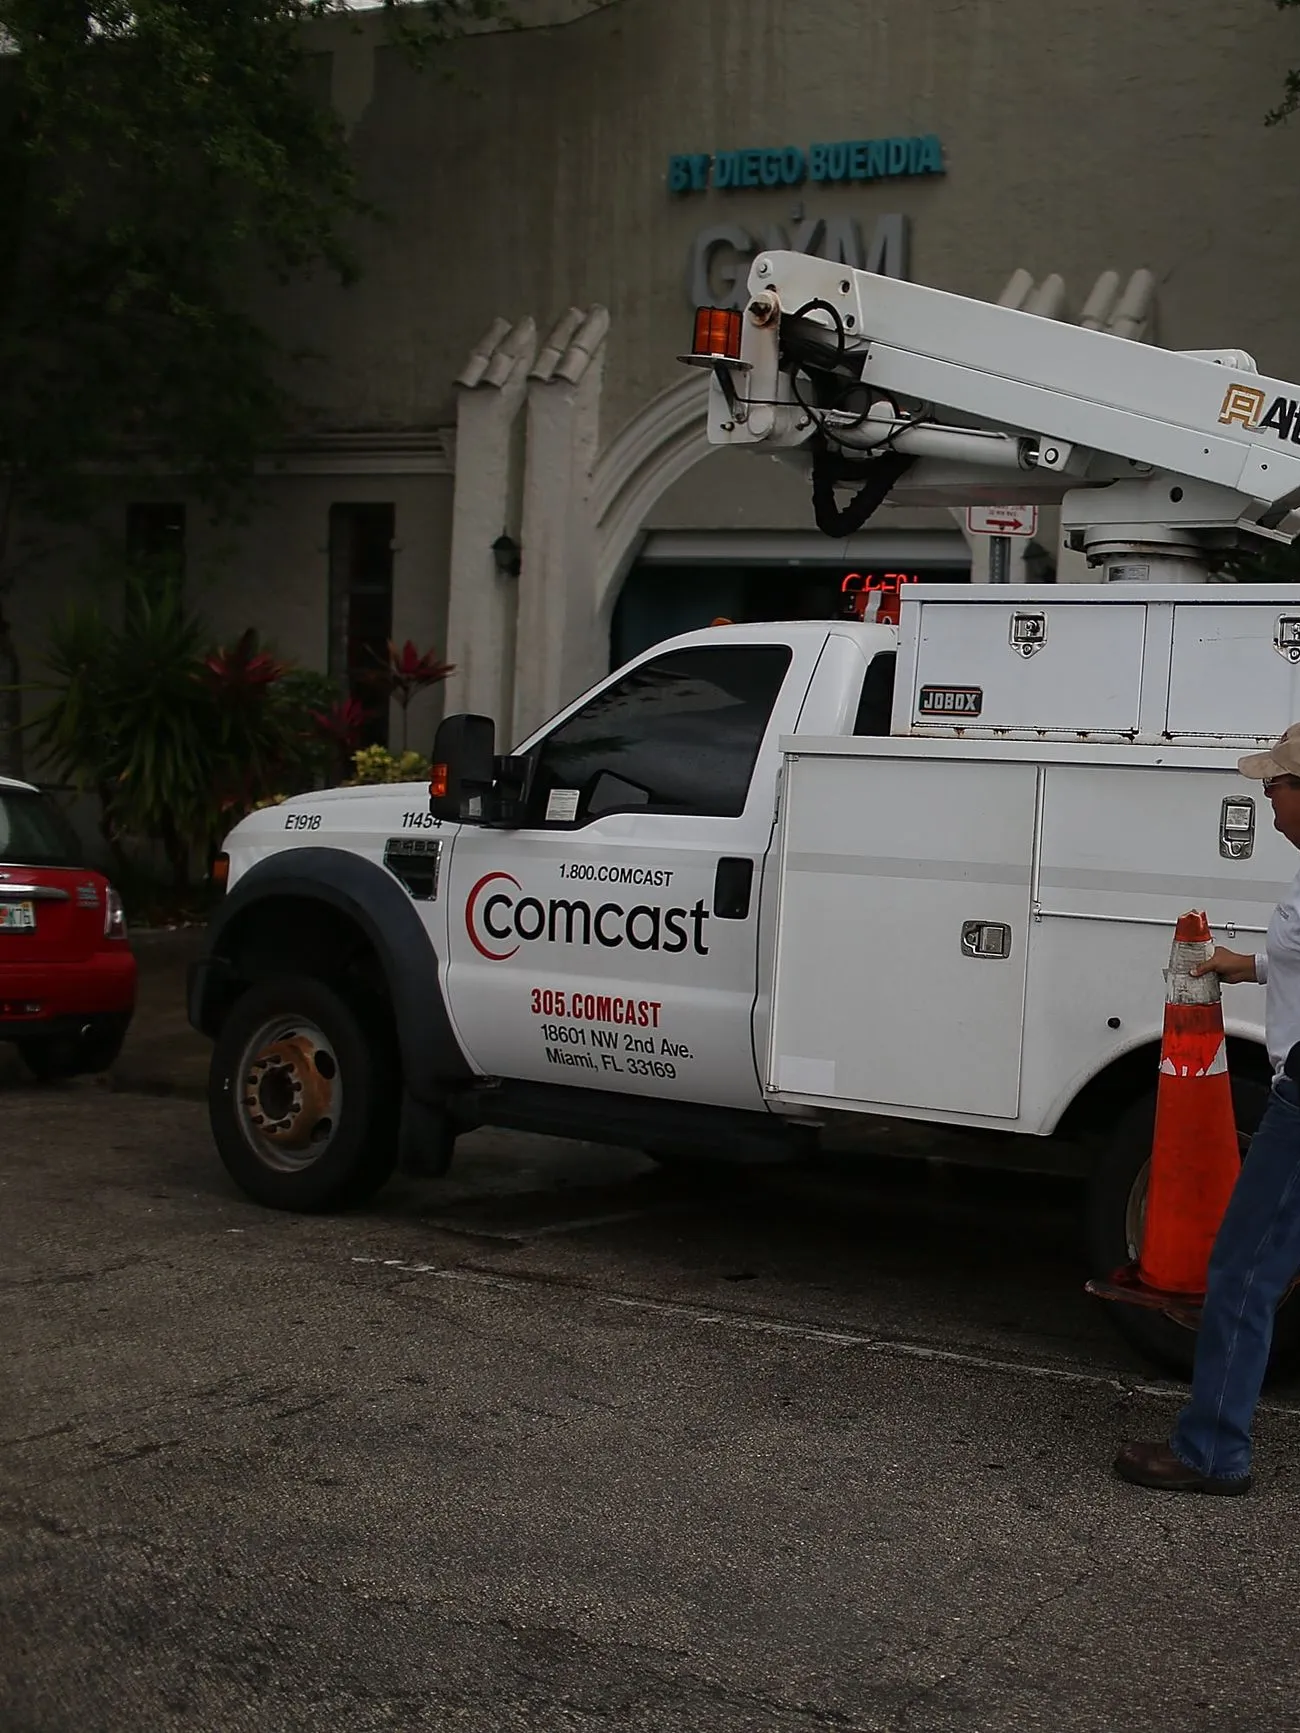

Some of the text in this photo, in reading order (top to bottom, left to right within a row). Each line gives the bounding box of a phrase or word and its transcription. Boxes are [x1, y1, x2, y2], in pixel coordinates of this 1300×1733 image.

[667, 134, 946, 192] BY DIEGO BUENDIA
[923, 692, 977, 711] JOBOX
[285, 814, 322, 830] E1918
[402, 812, 443, 829] 11454
[559, 863, 674, 887] 1.800.COMCAST
[531, 988, 662, 1028] 305.COMCAST
[541, 1024, 694, 1059] 18601 NW 2nd Ave.
[545, 1047, 677, 1079] Miami, FL 33169
